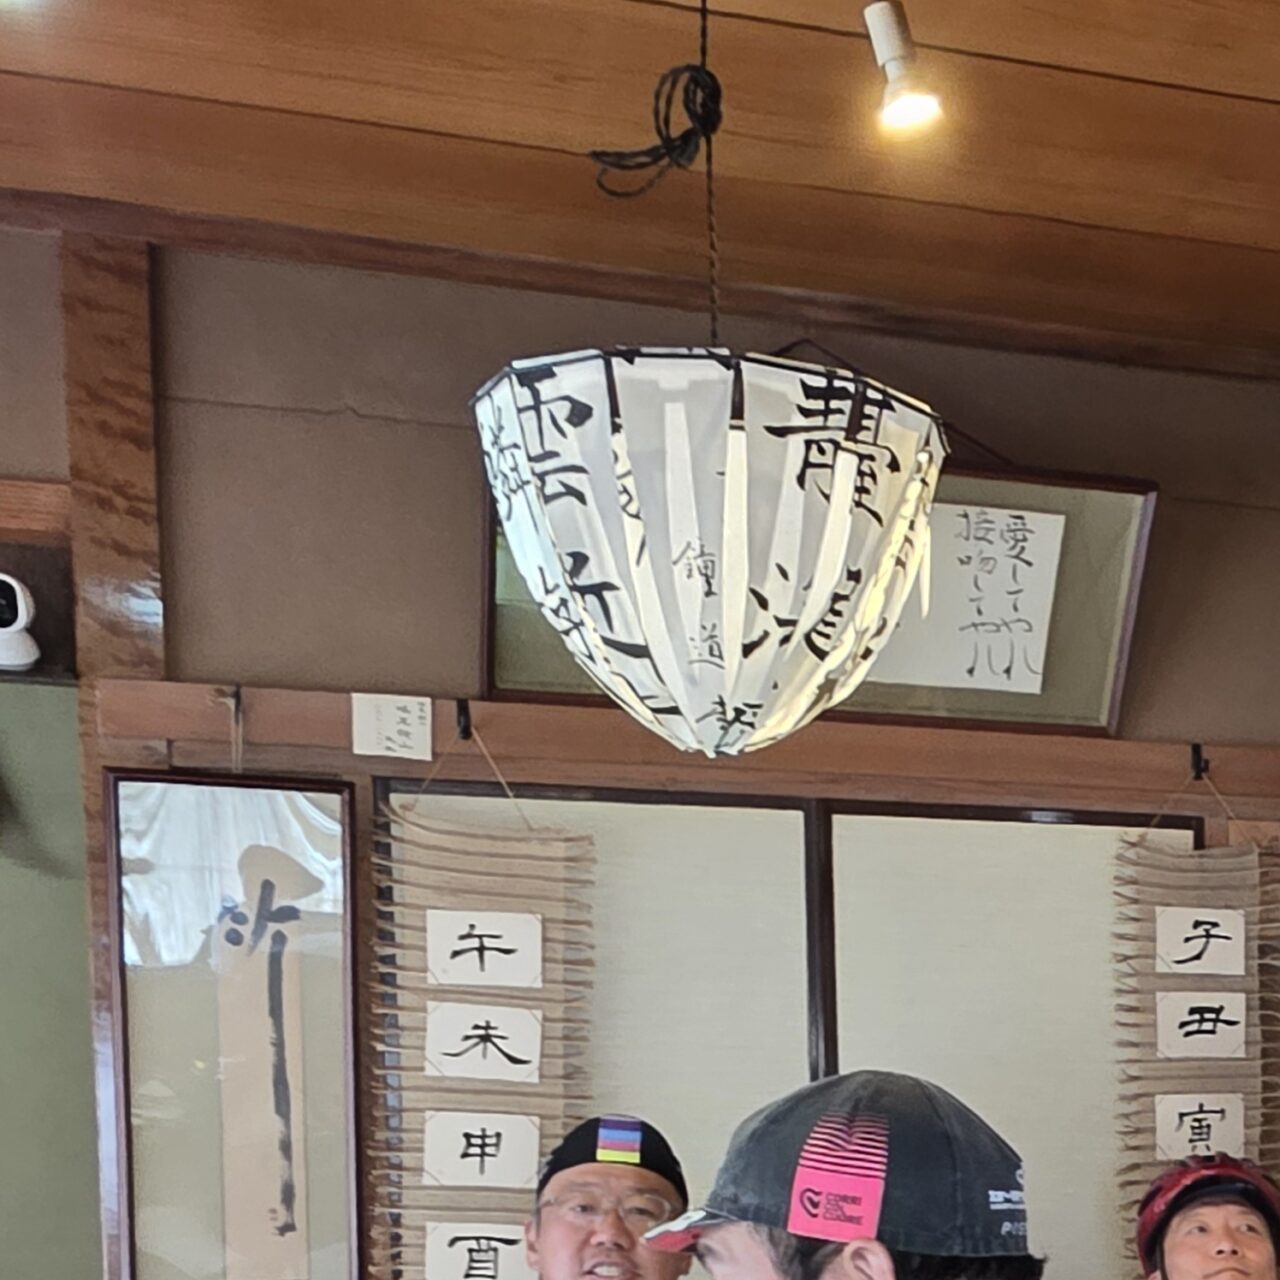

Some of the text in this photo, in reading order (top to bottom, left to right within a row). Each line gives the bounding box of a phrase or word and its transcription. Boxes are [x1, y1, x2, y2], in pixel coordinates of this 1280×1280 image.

[449, 923, 518, 973] 午
[1171, 918, 1233, 965] 子
[441, 1020, 532, 1066] 未
[1177, 1004, 1241, 1039] 丑
[460, 1126, 503, 1175] 申
[1174, 1102, 1227, 1153] 寅
[447, 1234, 522, 1280] 酉
